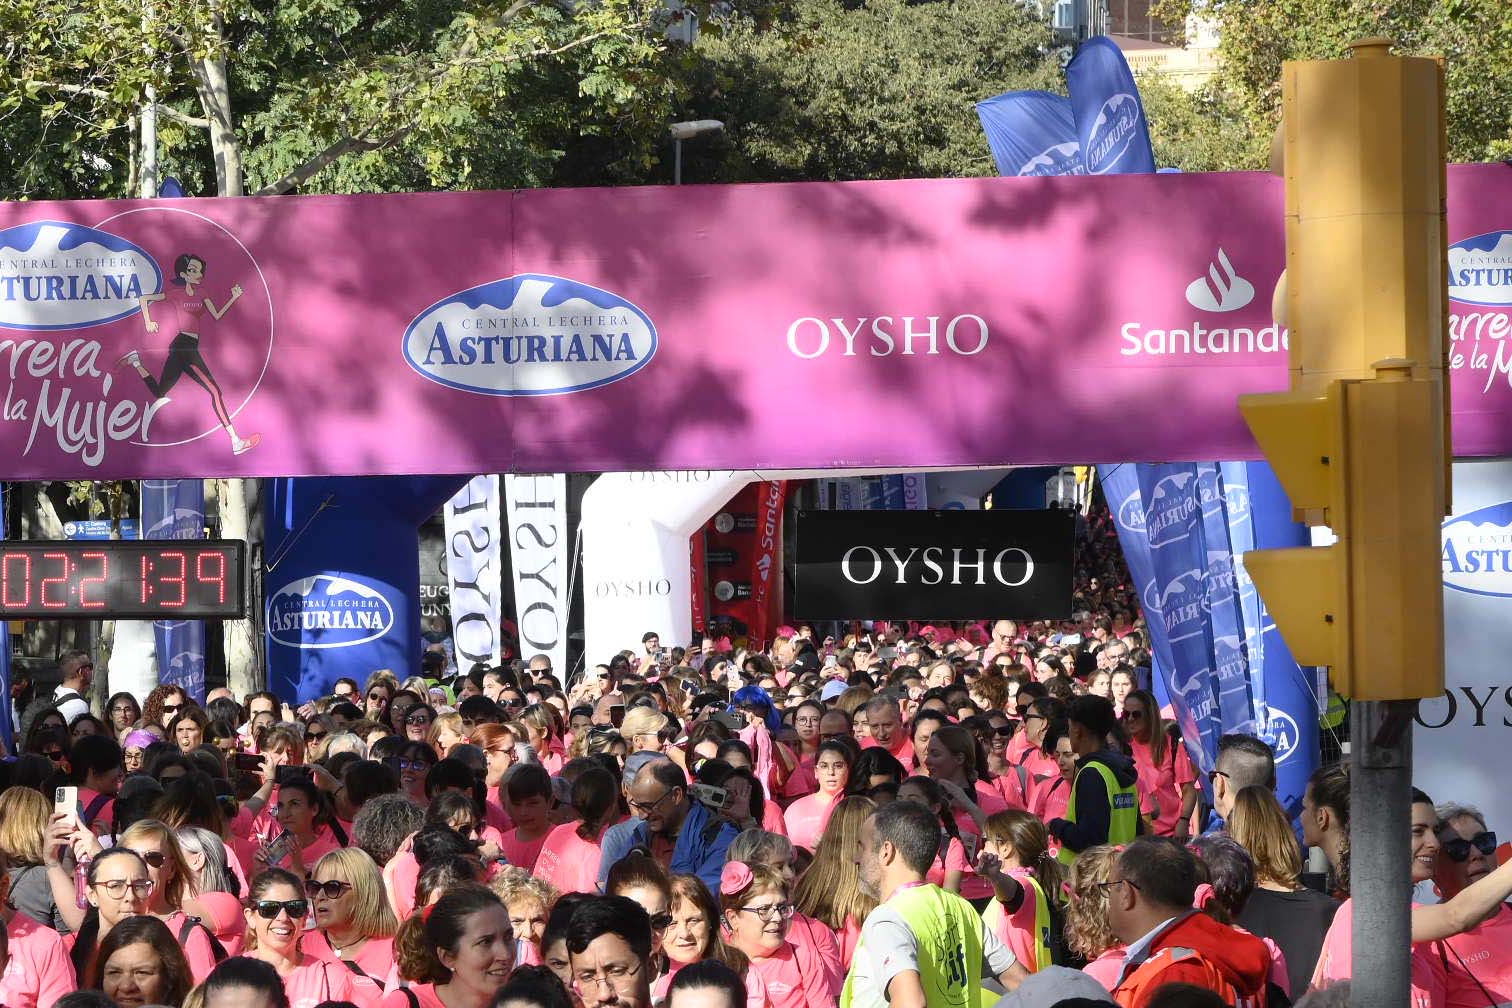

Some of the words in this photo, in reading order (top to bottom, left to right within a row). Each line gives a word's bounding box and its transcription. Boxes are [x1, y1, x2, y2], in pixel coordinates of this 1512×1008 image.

[65, 257, 137, 268] LECHERA
[461, 317, 540, 329] CENTRAL
[548, 314, 629, 327] LECHERA
[787, 313, 989, 358] OYSHO
[422, 321, 638, 365] ASTURIANA
[1470, 344, 1488, 369] la
[3, 380, 28, 421] la
[23, 373, 171, 467] Mujer
[841, 546, 1035, 587] OYSHO
[330, 599, 381, 608] LECHERA
[271, 605, 385, 633] ASTURIANA
